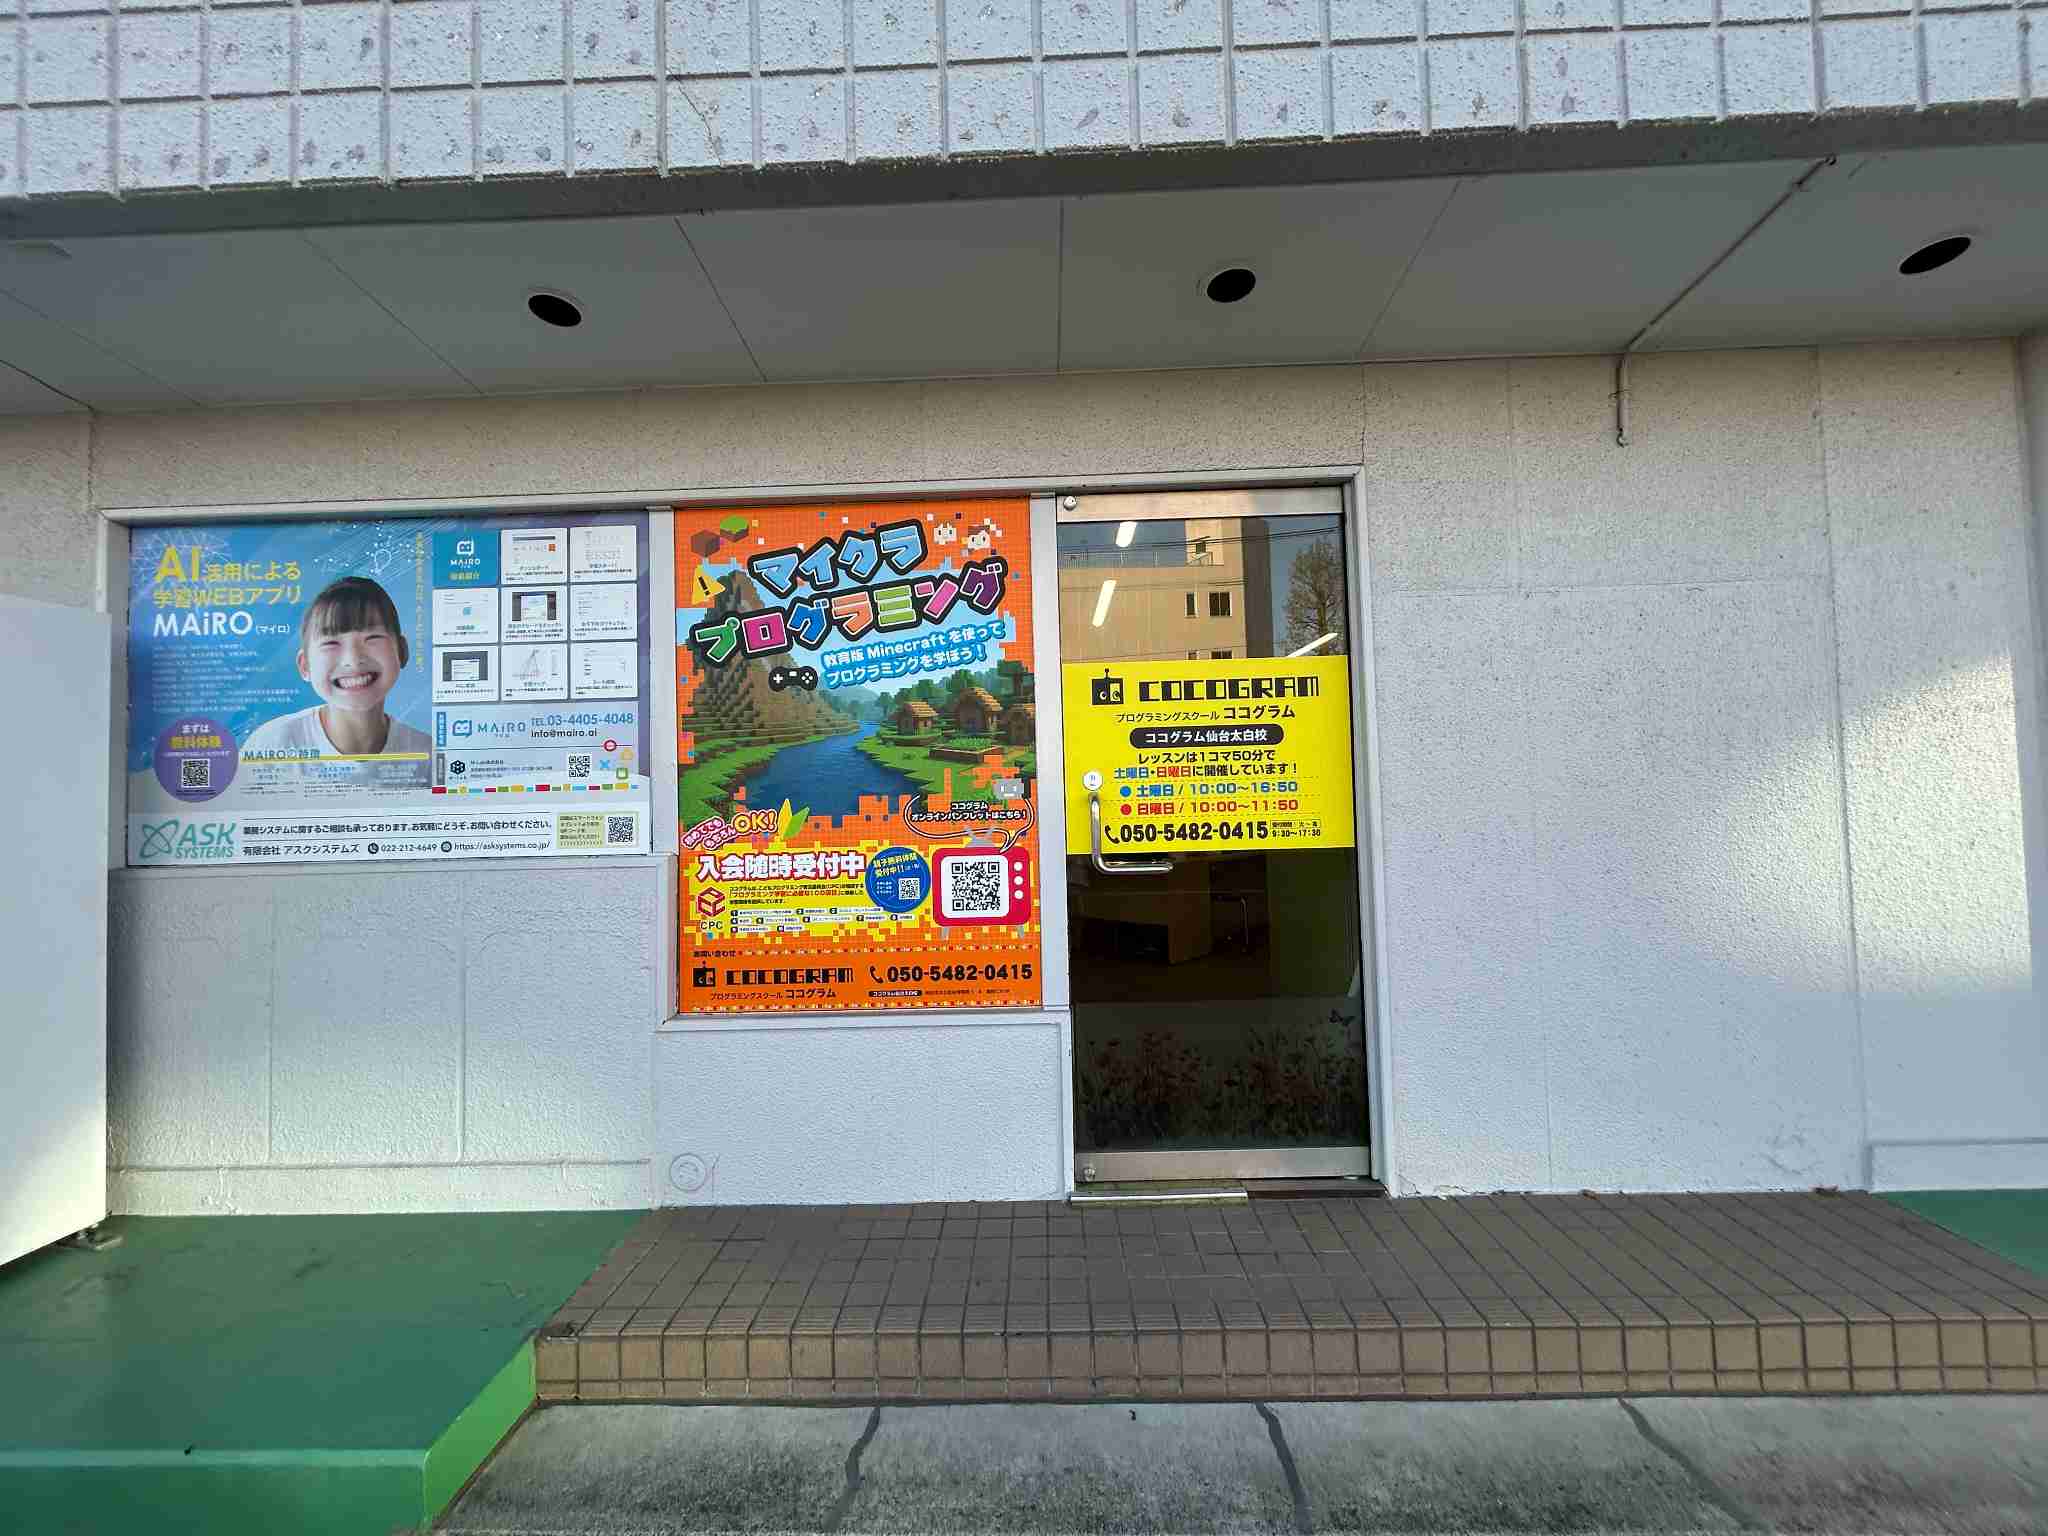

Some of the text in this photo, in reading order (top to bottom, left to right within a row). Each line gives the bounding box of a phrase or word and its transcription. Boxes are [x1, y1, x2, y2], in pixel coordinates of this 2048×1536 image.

[751, 520, 927, 597] マイクラ
[690, 557, 1005, 666] プログラミング
[153, 611, 254, 638] MAiRO
[823, 622, 1006, 669] 教育版 Minecraft を使って
[826, 645, 988, 686] プログラミングを学ぼう！
[1138, 676, 1319, 702] COCOGRAM
[1116, 704, 1297, 723] プログラミングスクール ココグラム
[530, 728, 598, 738] info@mairo.ai
[1145, 728, 1269, 745] ココグラム仙台太白校
[1138, 750, 1276, 765] レッスンは1コマ50分で
[1113, 763, 1298, 779] 土曜日・日曜日に開催しています！
[951, 801, 988, 811] ココグラム
[734, 811, 776, 833] OK!
[1120, 822, 1269, 843] 050-5482-0415
[178, 823, 237, 846] ASK
[176, 846, 234, 859] SYSTEMS
[243, 845, 281, 856] 有限会社
[284, 843, 361, 855] アスクシステムズ
[381, 843, 437, 852] 022-212-4649
[454, 839, 551, 851] https://asksystems.co.jp/
[698, 851, 866, 881] 入会随時受付中
[700, 921, 724, 930] CPC
[725, 963, 1033, 986] COCOGRAM 050-5482-0415
[711, 988, 837, 1000] プログラミングスクール ココグラム
